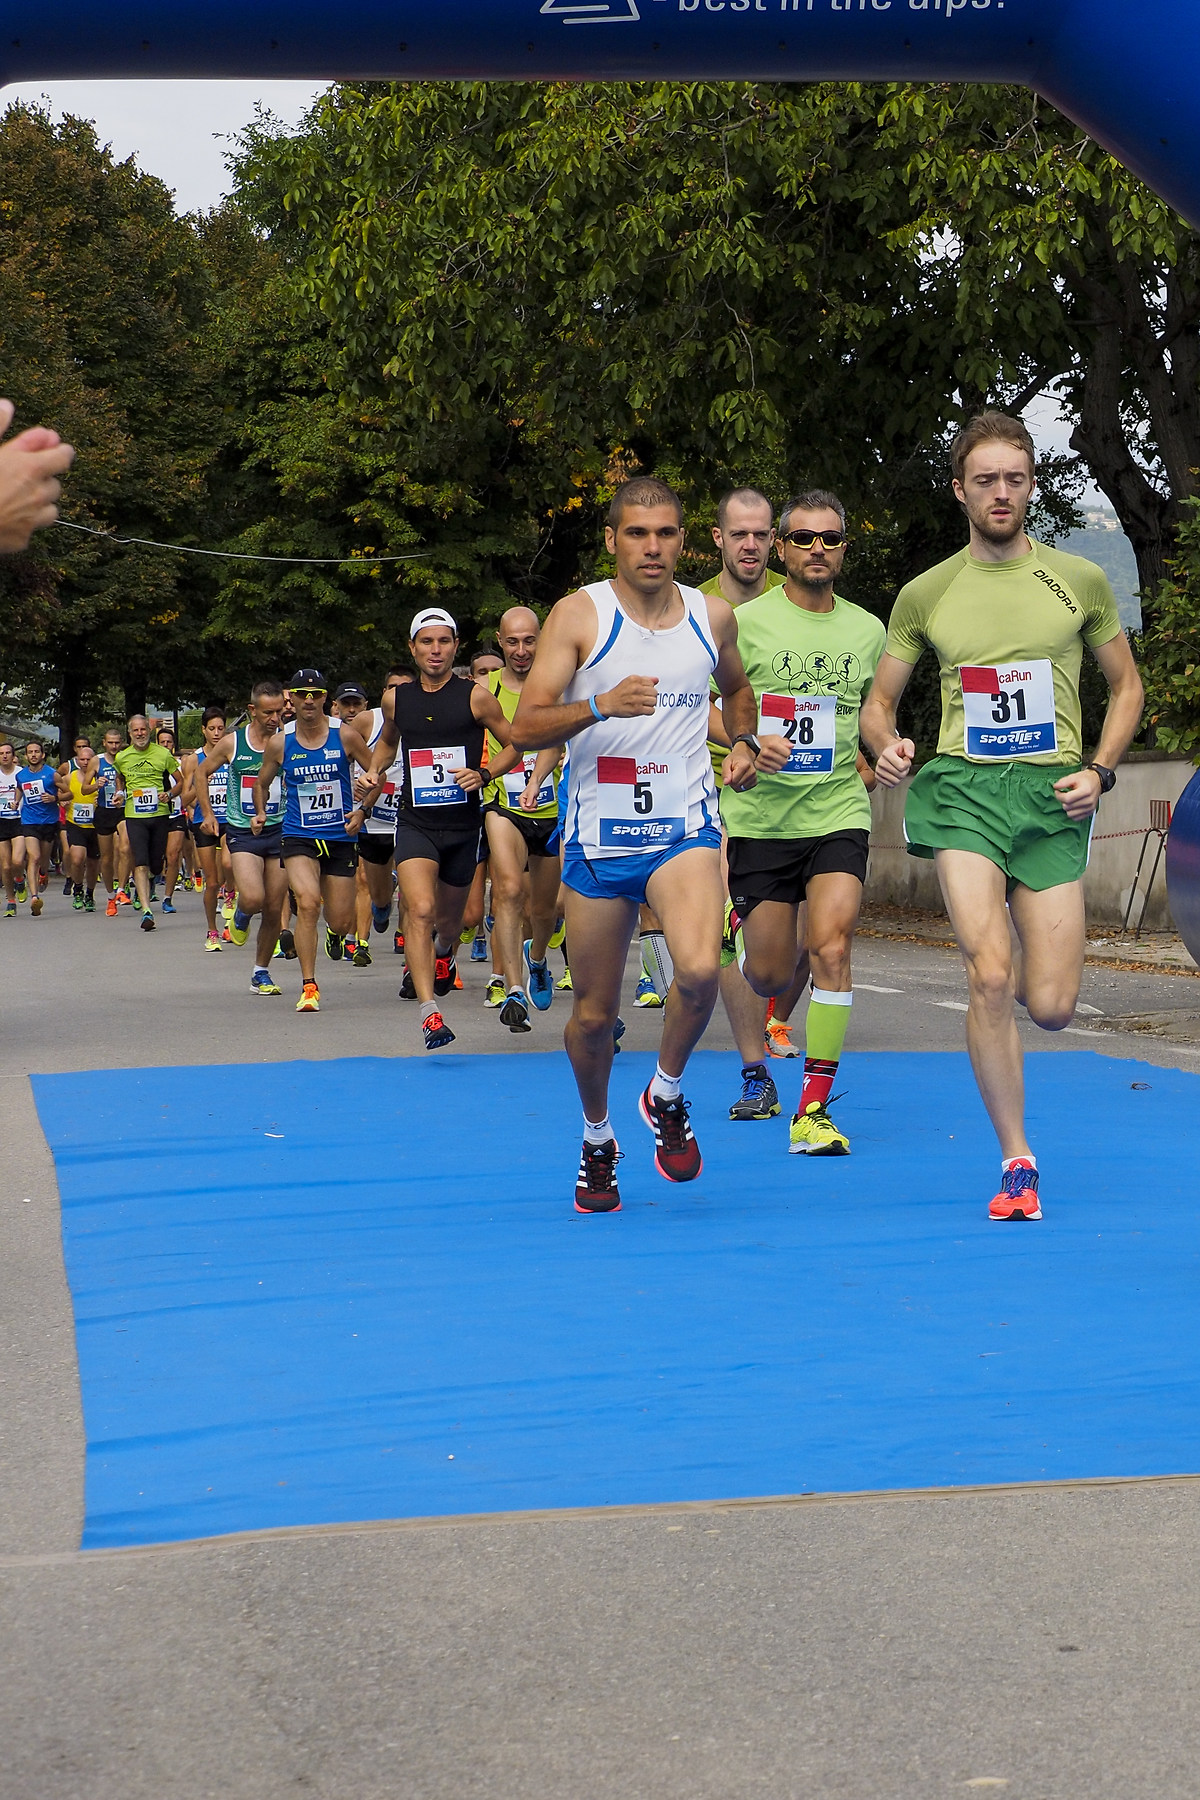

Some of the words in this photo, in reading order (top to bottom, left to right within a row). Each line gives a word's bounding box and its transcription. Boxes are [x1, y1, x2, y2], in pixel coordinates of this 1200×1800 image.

[1033, 569, 1077, 615] DIADORA
[998, 669, 1033, 684] caRun
[795, 701, 820, 712] caRun
[990, 688, 1026, 724] 31
[782, 716, 814, 745] 28
[979, 729, 1042, 746] SPORTLER
[294, 763, 338, 776] ATLETICA
[432, 763, 445, 784] 3
[636, 762, 669, 775] caRun
[304, 773, 330, 782] MALO
[308, 792, 334, 810] 247
[634, 781, 653, 815] 5
[611, 821, 673, 837] SPORTLER
